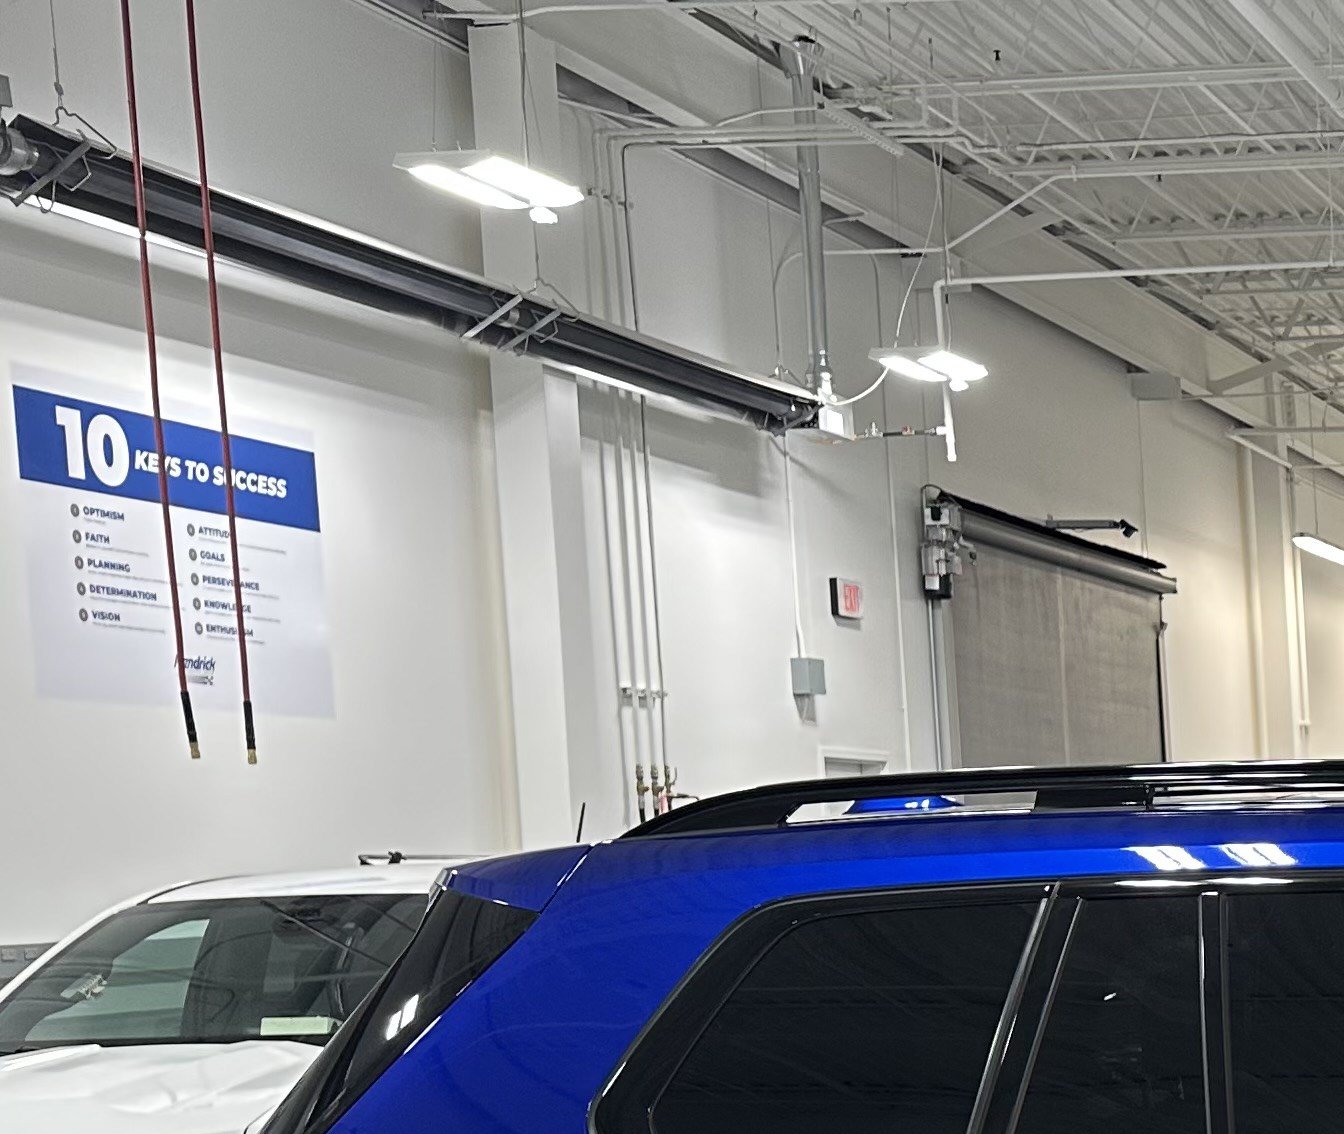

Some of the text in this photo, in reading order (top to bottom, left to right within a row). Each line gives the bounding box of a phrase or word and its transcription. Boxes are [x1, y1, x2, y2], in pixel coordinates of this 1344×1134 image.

[55, 405, 130, 487] 10
[185, 459, 209, 483] TO
[83, 505, 125, 521] OPTIMISM
[85, 531, 110, 544] FAITH
[199, 526, 230, 539] ATTITUD
[200, 550, 225, 562] GOALS
[87, 558, 130, 573] PLANNING
[89, 583, 157, 601] DETERMINATION
[91, 610, 121, 622] VISION
